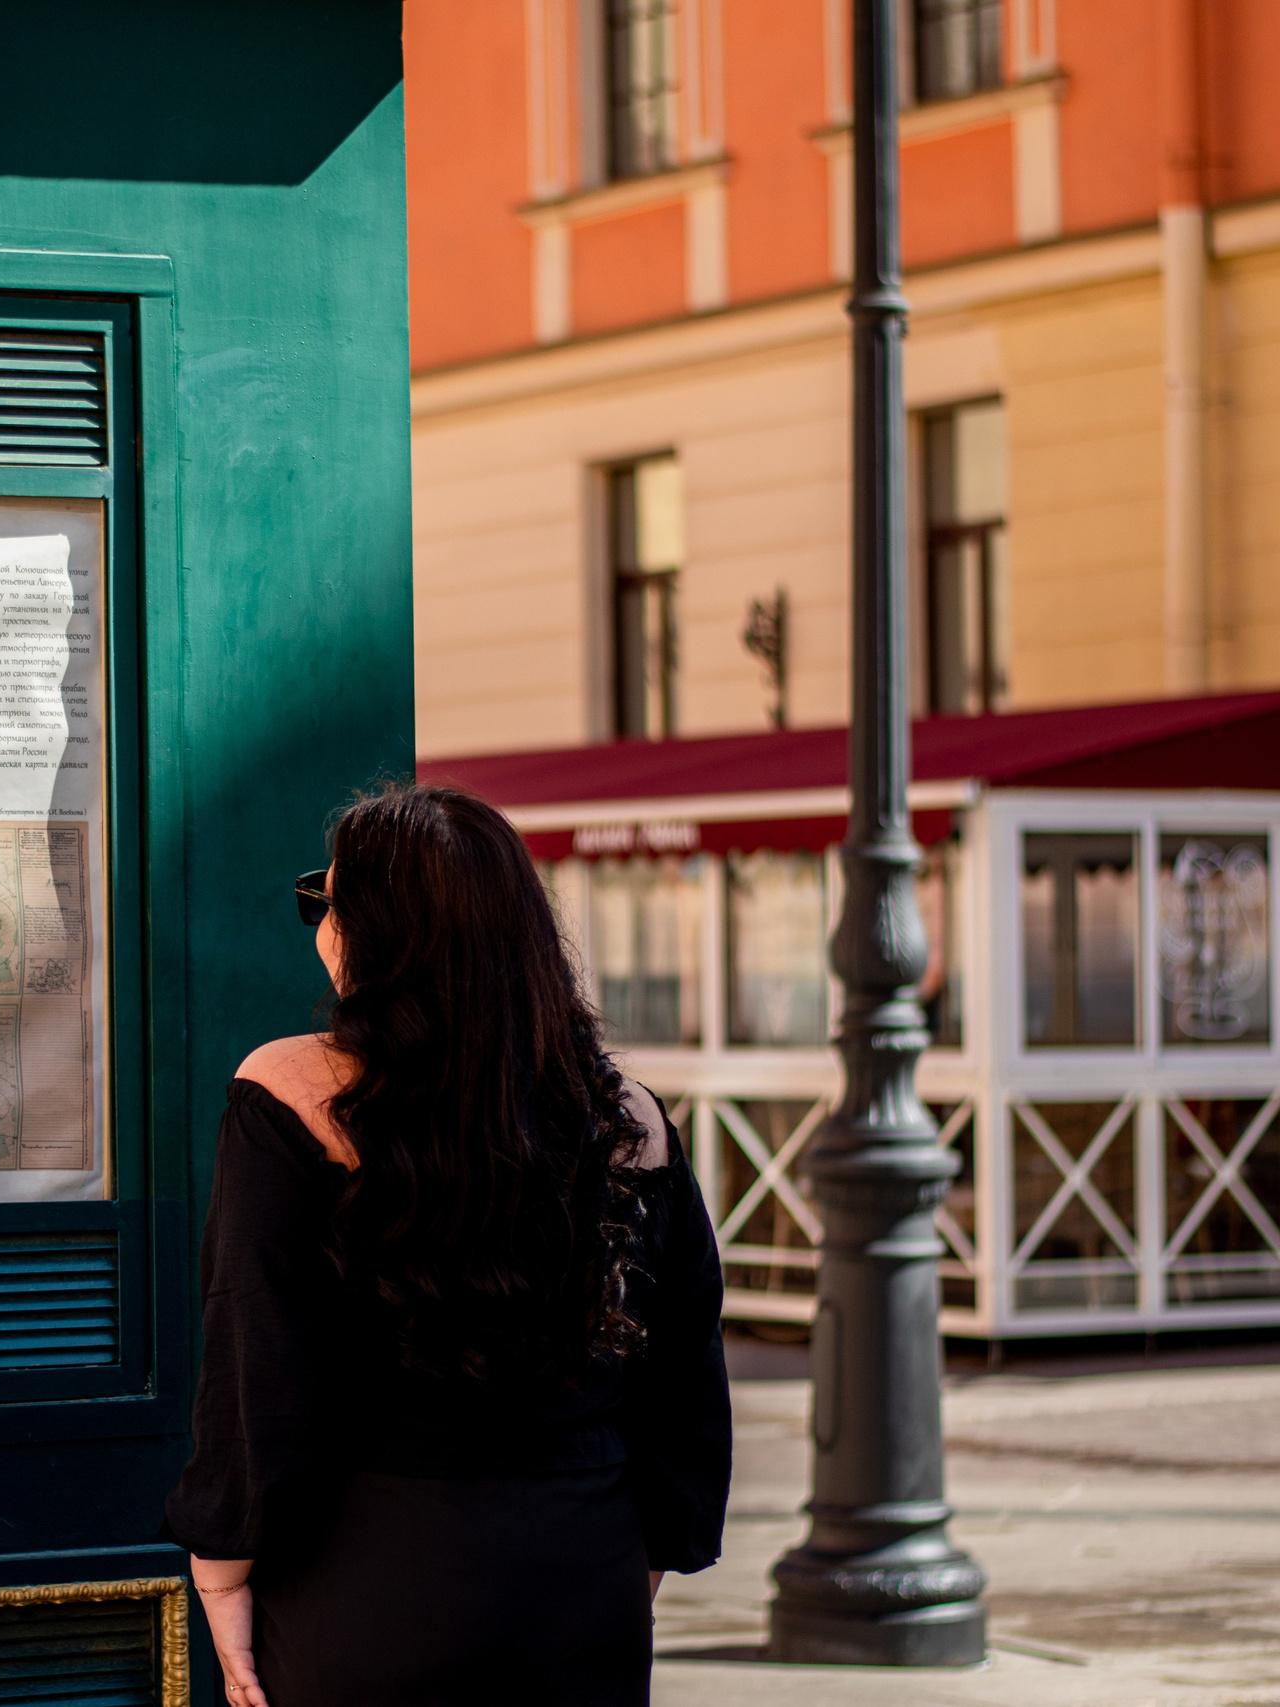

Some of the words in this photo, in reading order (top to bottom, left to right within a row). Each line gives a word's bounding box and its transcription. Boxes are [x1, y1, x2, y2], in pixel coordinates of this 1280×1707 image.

[68, 568, 88, 578] улице
[24, 594, 48, 602] заказу
[2, 607, 48, 615] установили
[71, 709, 88, 718] было
[22, 747, 47, 756] России
[25, 762, 48, 771] карта
